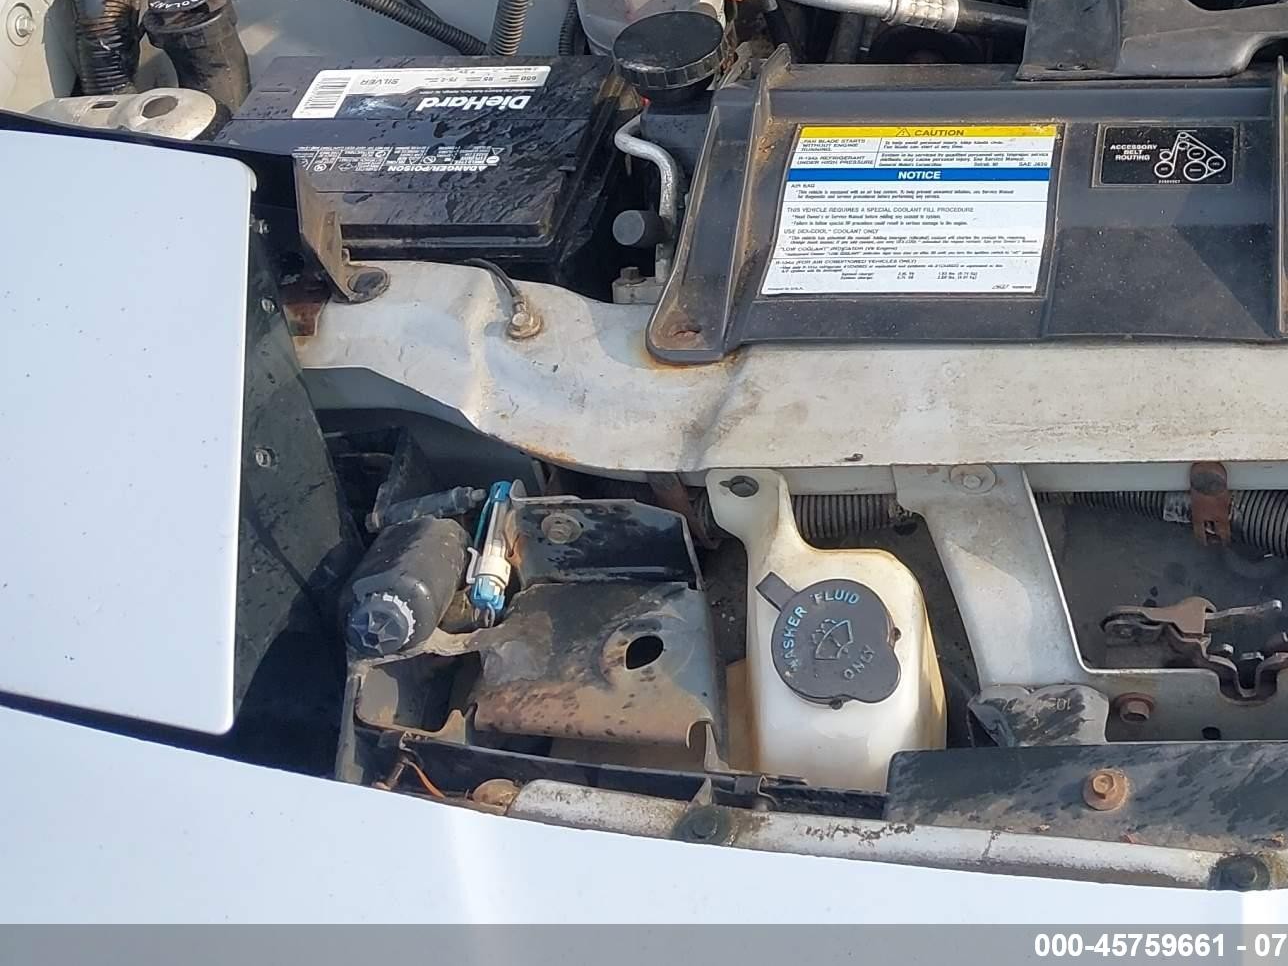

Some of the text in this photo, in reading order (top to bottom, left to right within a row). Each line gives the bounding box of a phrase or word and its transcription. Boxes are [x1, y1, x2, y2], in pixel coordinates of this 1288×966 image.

[415, 95, 531, 111] DieHard
[898, 171, 941, 179] NOTICE
[812, 589, 860, 604] FLUID
[843, 645, 876, 680] ONLY
